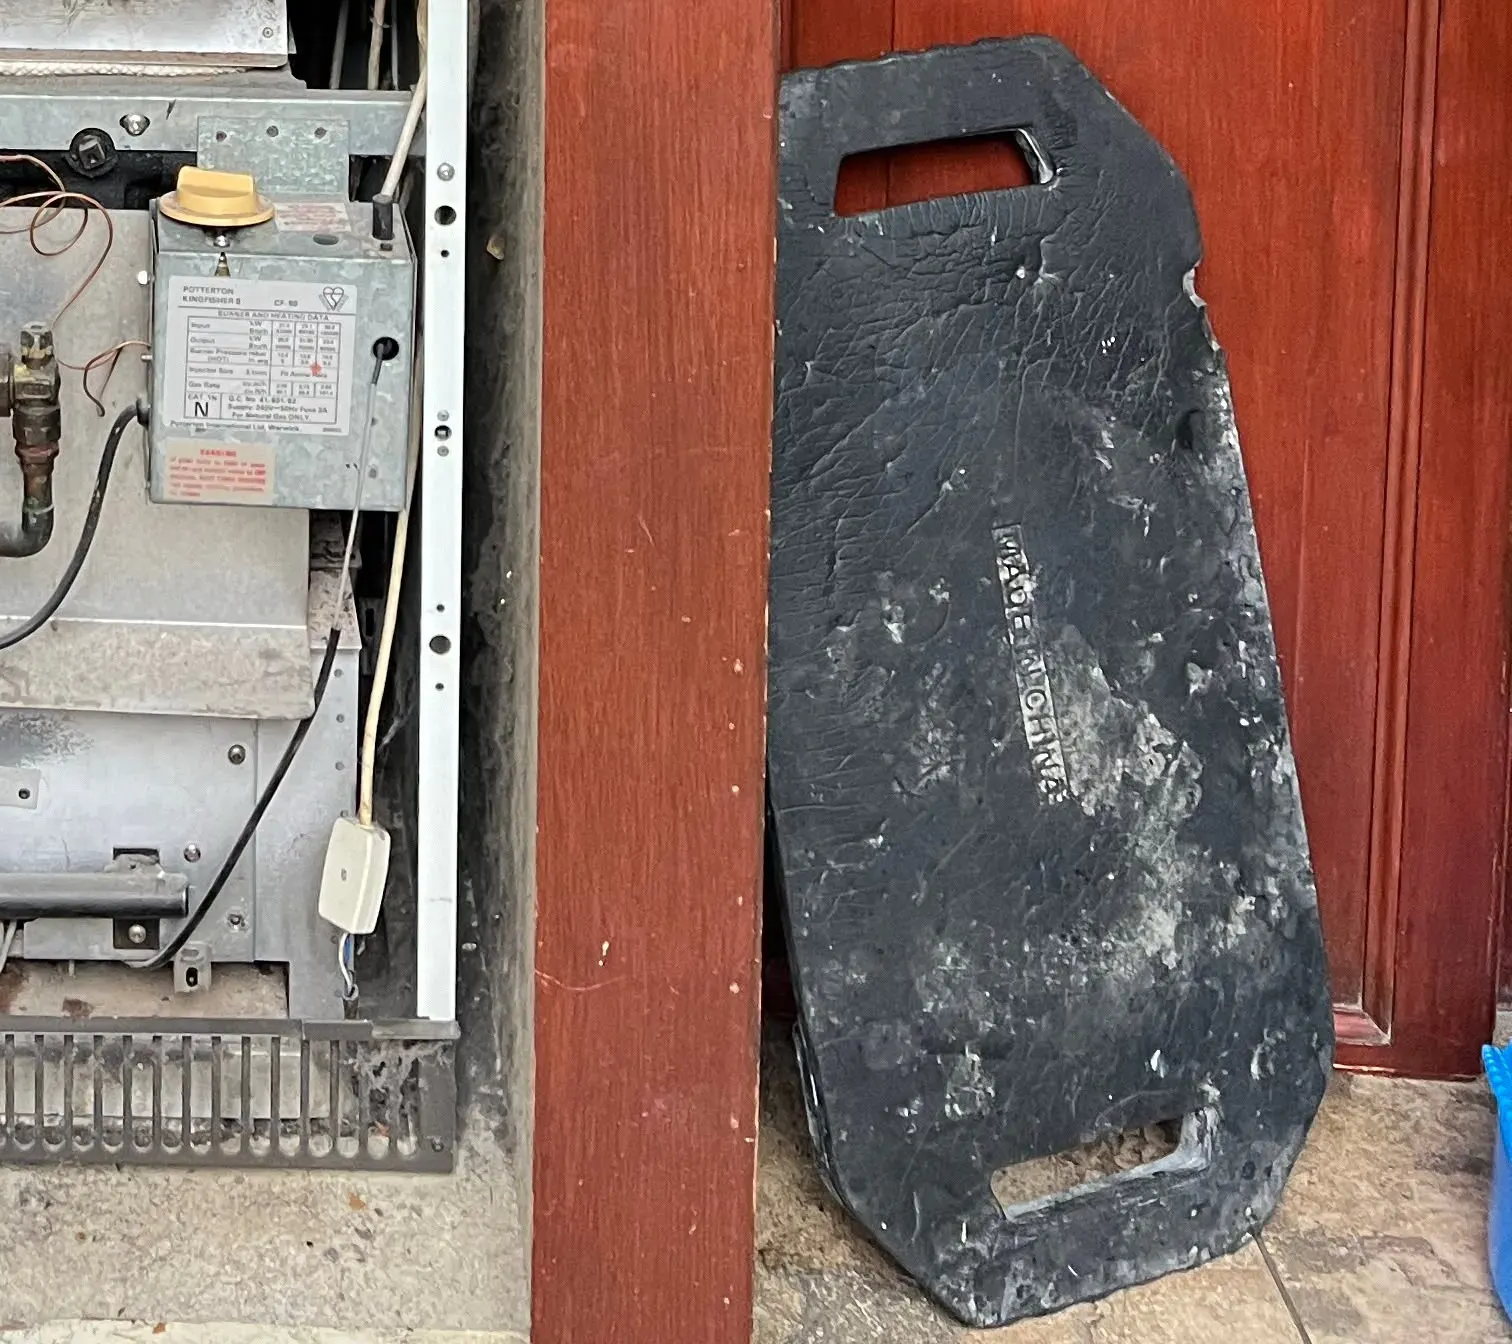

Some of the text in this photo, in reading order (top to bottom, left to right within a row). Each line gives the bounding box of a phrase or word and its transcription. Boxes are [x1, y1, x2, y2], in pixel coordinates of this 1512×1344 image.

[183, 285, 234, 295] POTTERTON
[182, 295, 235, 305] KINGFISHER
[194, 401, 209, 417] N
[996, 533, 1034, 630] MADE
[1024, 688, 1067, 806] CHINA
